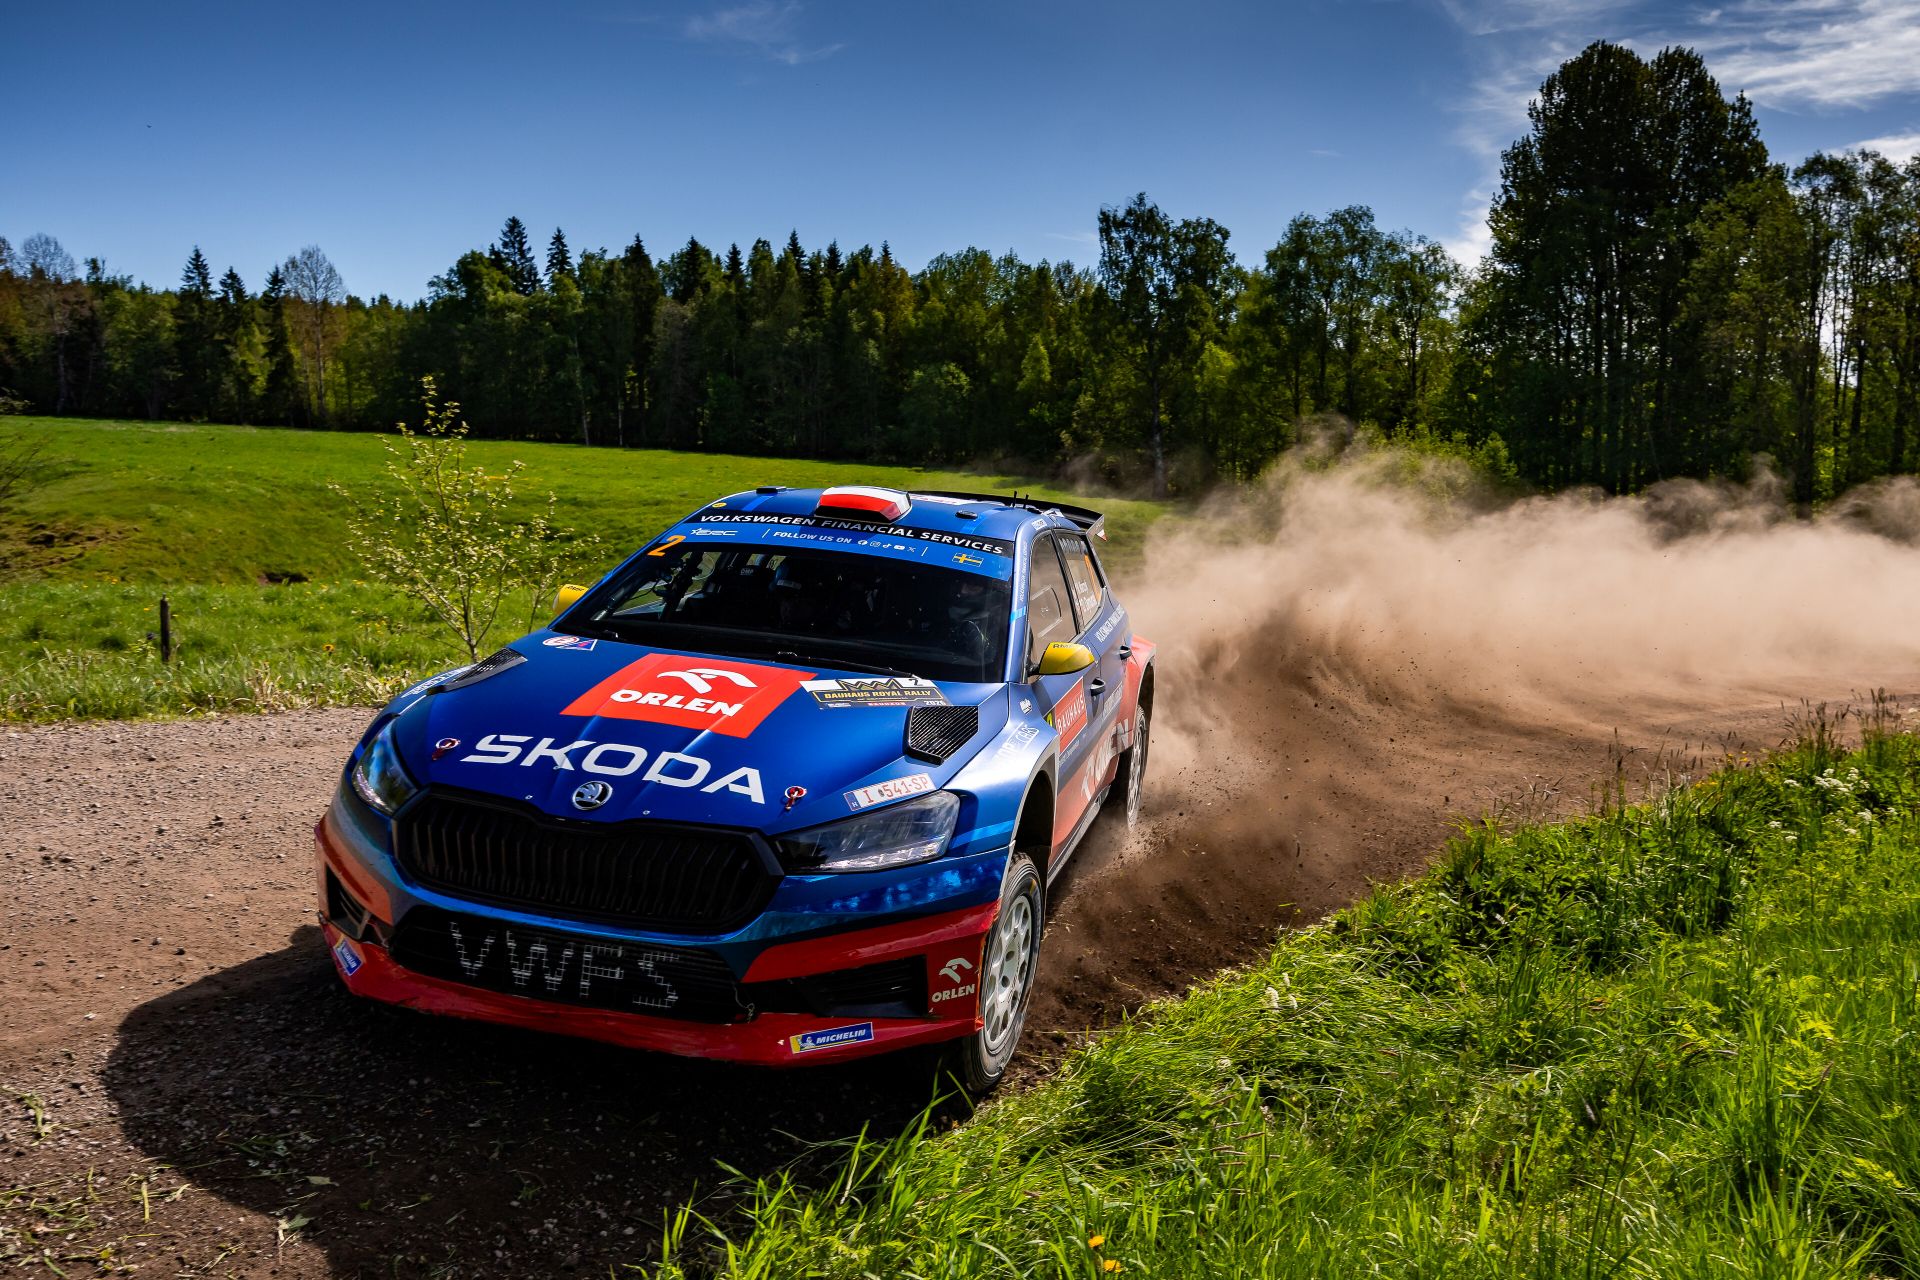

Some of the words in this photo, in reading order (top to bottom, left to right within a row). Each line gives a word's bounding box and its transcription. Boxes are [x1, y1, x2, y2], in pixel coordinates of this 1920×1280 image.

[647, 535, 687, 557] 2
[700, 515, 816, 527] VOLKSWAGEN
[821, 519, 914, 538] FINANCIAL
[920, 531, 1003, 554] SERVICES
[773, 531, 818, 540] FOLLOW
[610, 689, 744, 717] ORLEN
[1057, 694, 1085, 736] BAUHAUS
[863, 789, 874, 804] I
[882, 776, 929, 798] 541-SP
[931, 983, 976, 1003] ORLEN
[816, 1029, 866, 1045] MICHELIN
